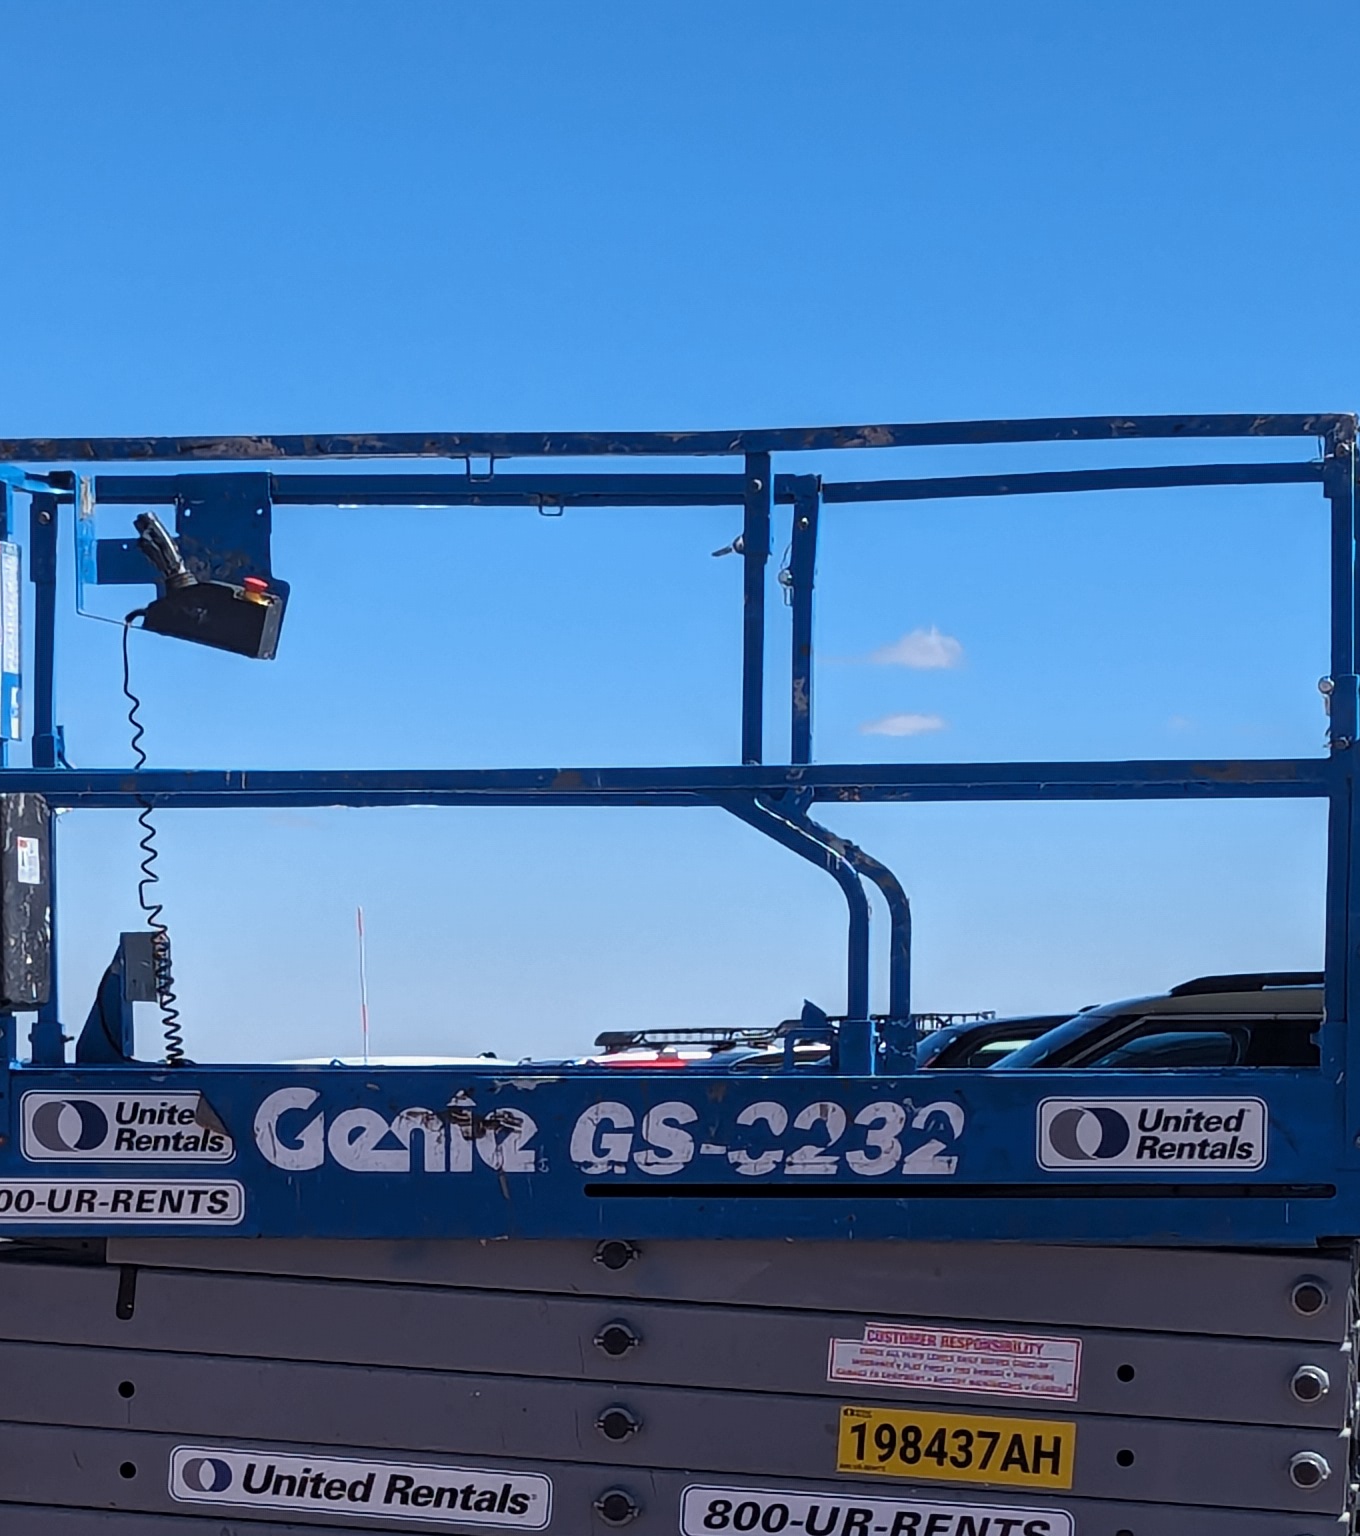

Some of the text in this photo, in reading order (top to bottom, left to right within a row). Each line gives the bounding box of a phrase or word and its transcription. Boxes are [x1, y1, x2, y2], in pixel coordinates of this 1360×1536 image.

[114, 1101, 196, 1126] Unite
[1137, 1107, 1246, 1133] United
[113, 1127, 226, 1153] Rentals
[253, 1087, 539, 1173] Genie
[1135, 1135, 1255, 1161] Rentals
[867, 1329, 1045, 1355] CUSTOMER RESPONSIBILITY
[849, 1421, 1063, 1476] 198437AH
[241, 1462, 531, 1516] United Rentals
